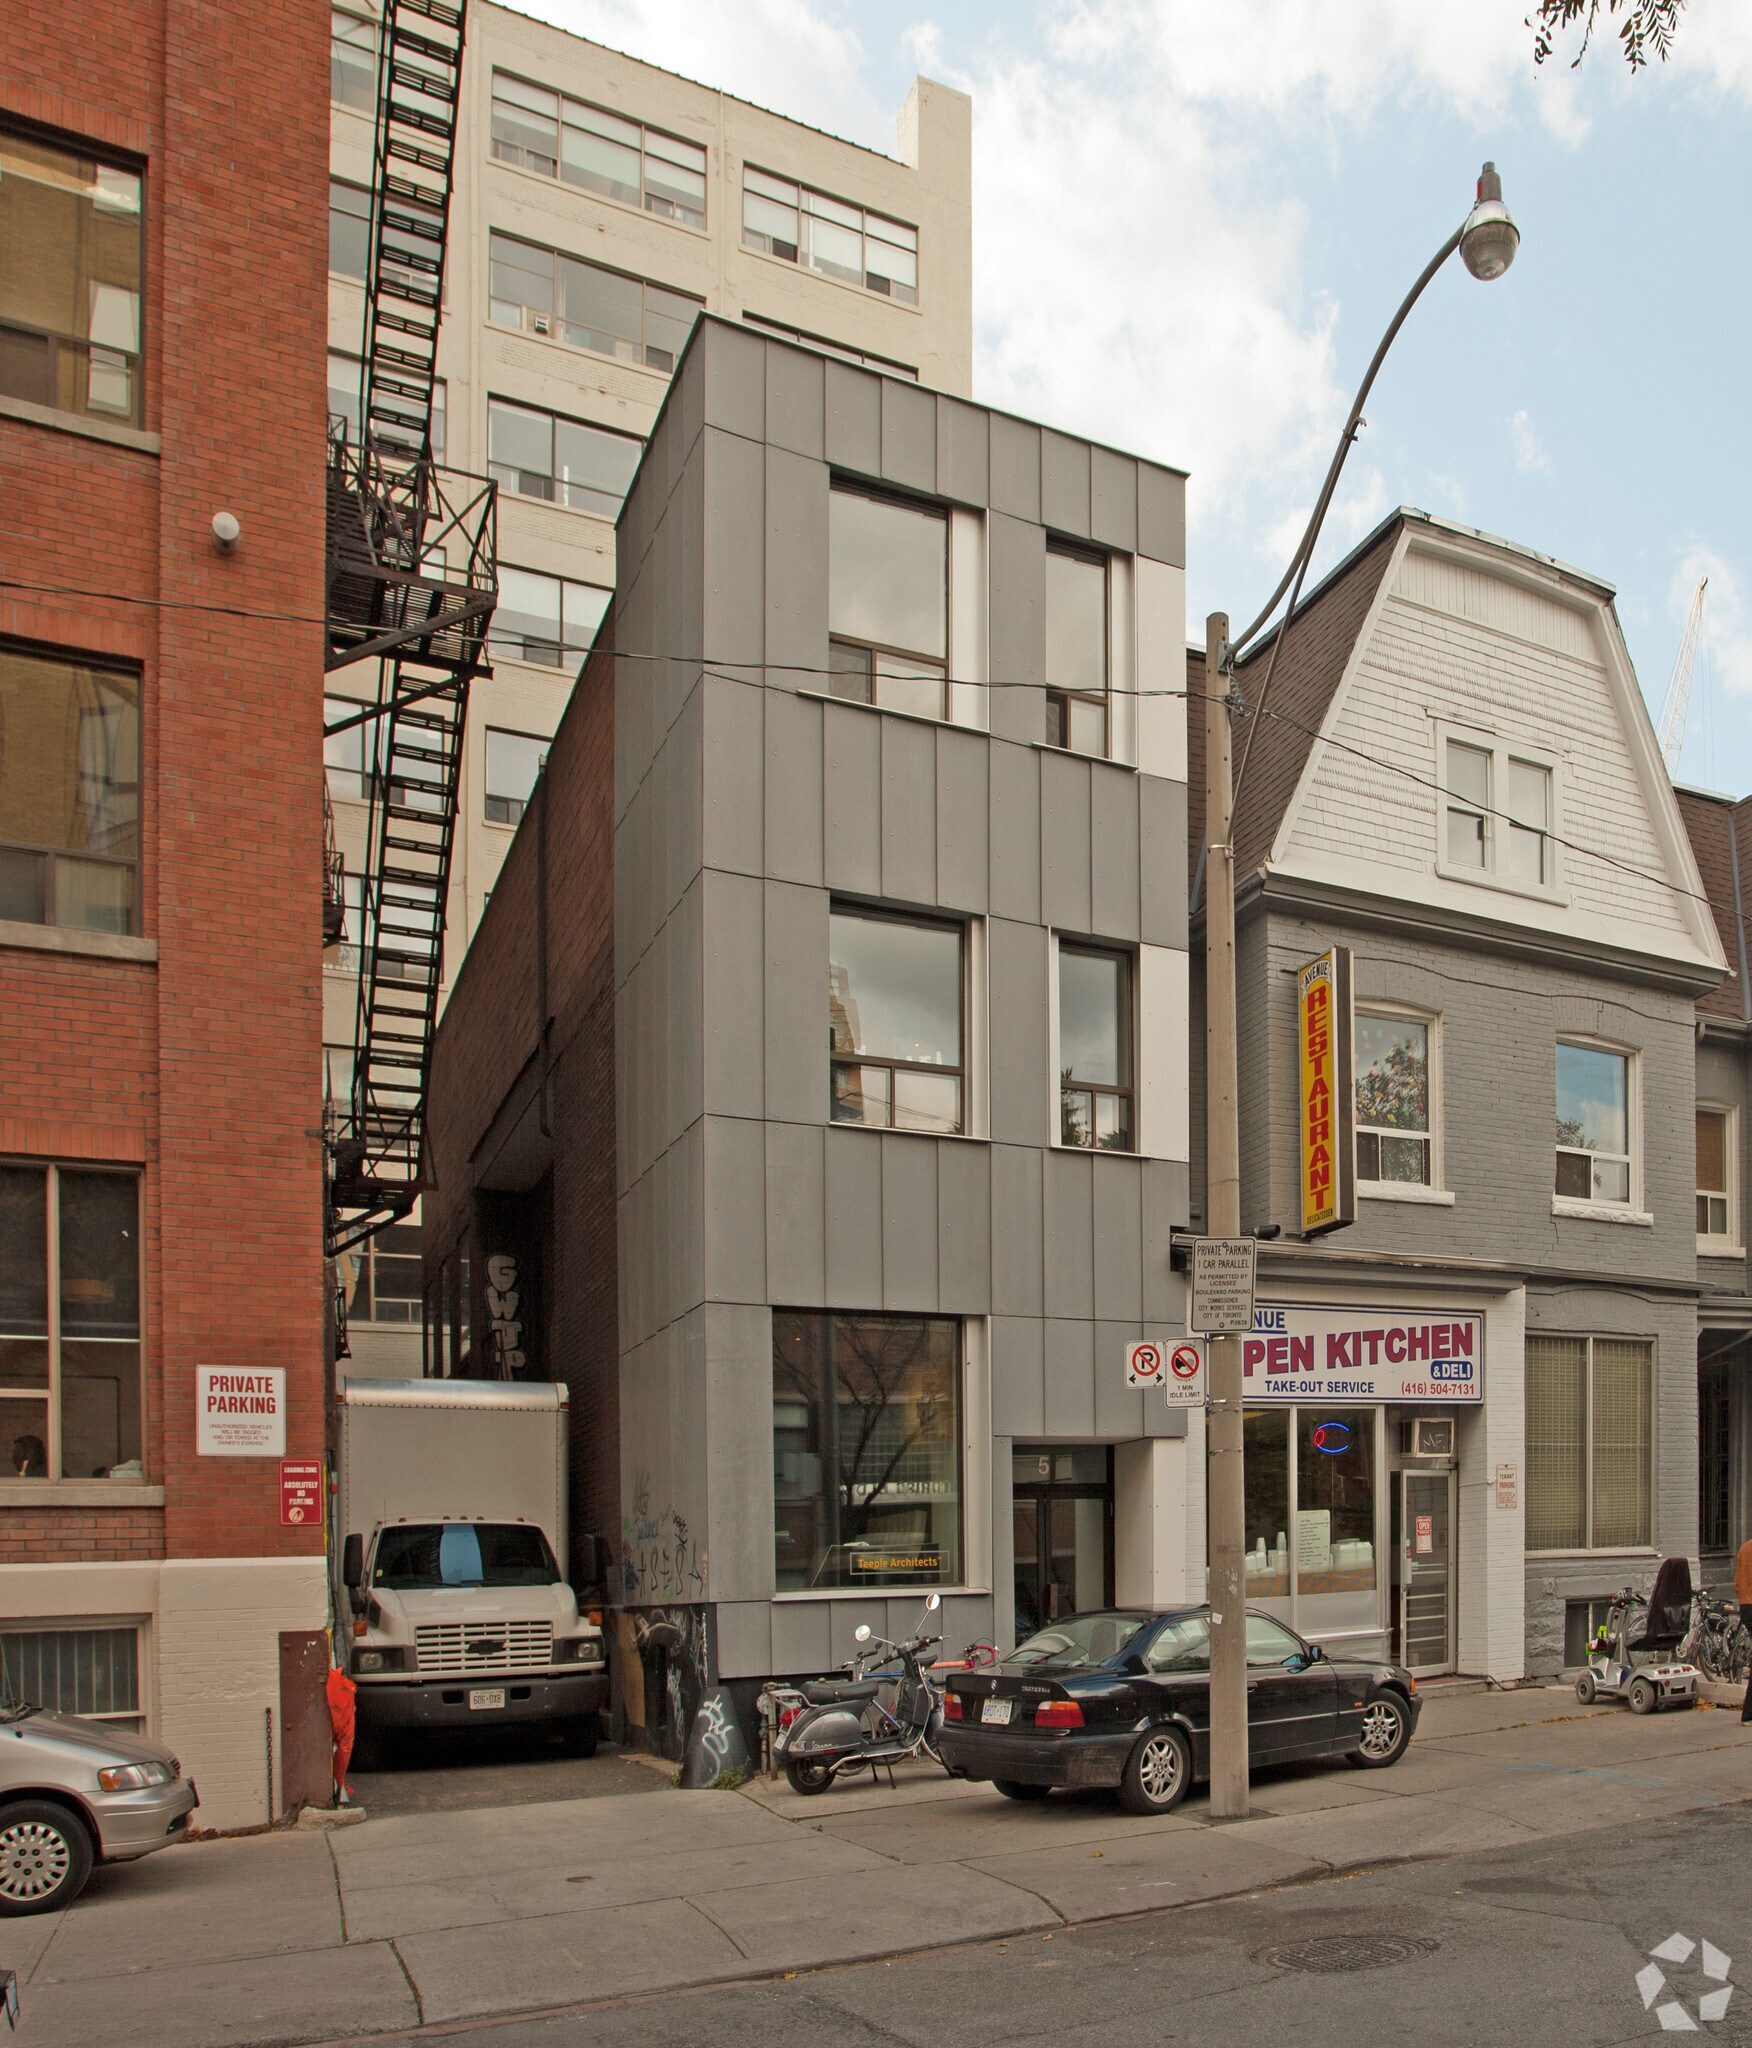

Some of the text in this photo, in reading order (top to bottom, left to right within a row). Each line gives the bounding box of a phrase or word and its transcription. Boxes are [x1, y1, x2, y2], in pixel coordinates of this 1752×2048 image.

[1305, 961, 1328, 988] AVENUE
[1307, 985, 1329, 1211] RESTAURANT
[1307, 1207, 1333, 1226] DELICATESSEN
[1197, 1244, 1252, 1256] PRIVATE PARKING
[1203, 1260, 1216, 1269] CAR
[1218, 1259, 1250, 1269] PARALLEL
[1254, 1310, 1286, 1329] NUE
[1243, 1322, 1473, 1378] PEN KITCHEN
[209, 1375, 274, 1393] PRIVATE
[1265, 1380, 1475, 1395] TAKE-OUT SERVICE (416) 504-7131
[207, 1395, 276, 1414] PARKING
[1038, 1456, 1050, 1475] 5
[297, 1489, 306, 1497] NO
[857, 1558, 888, 1569] Teeple
